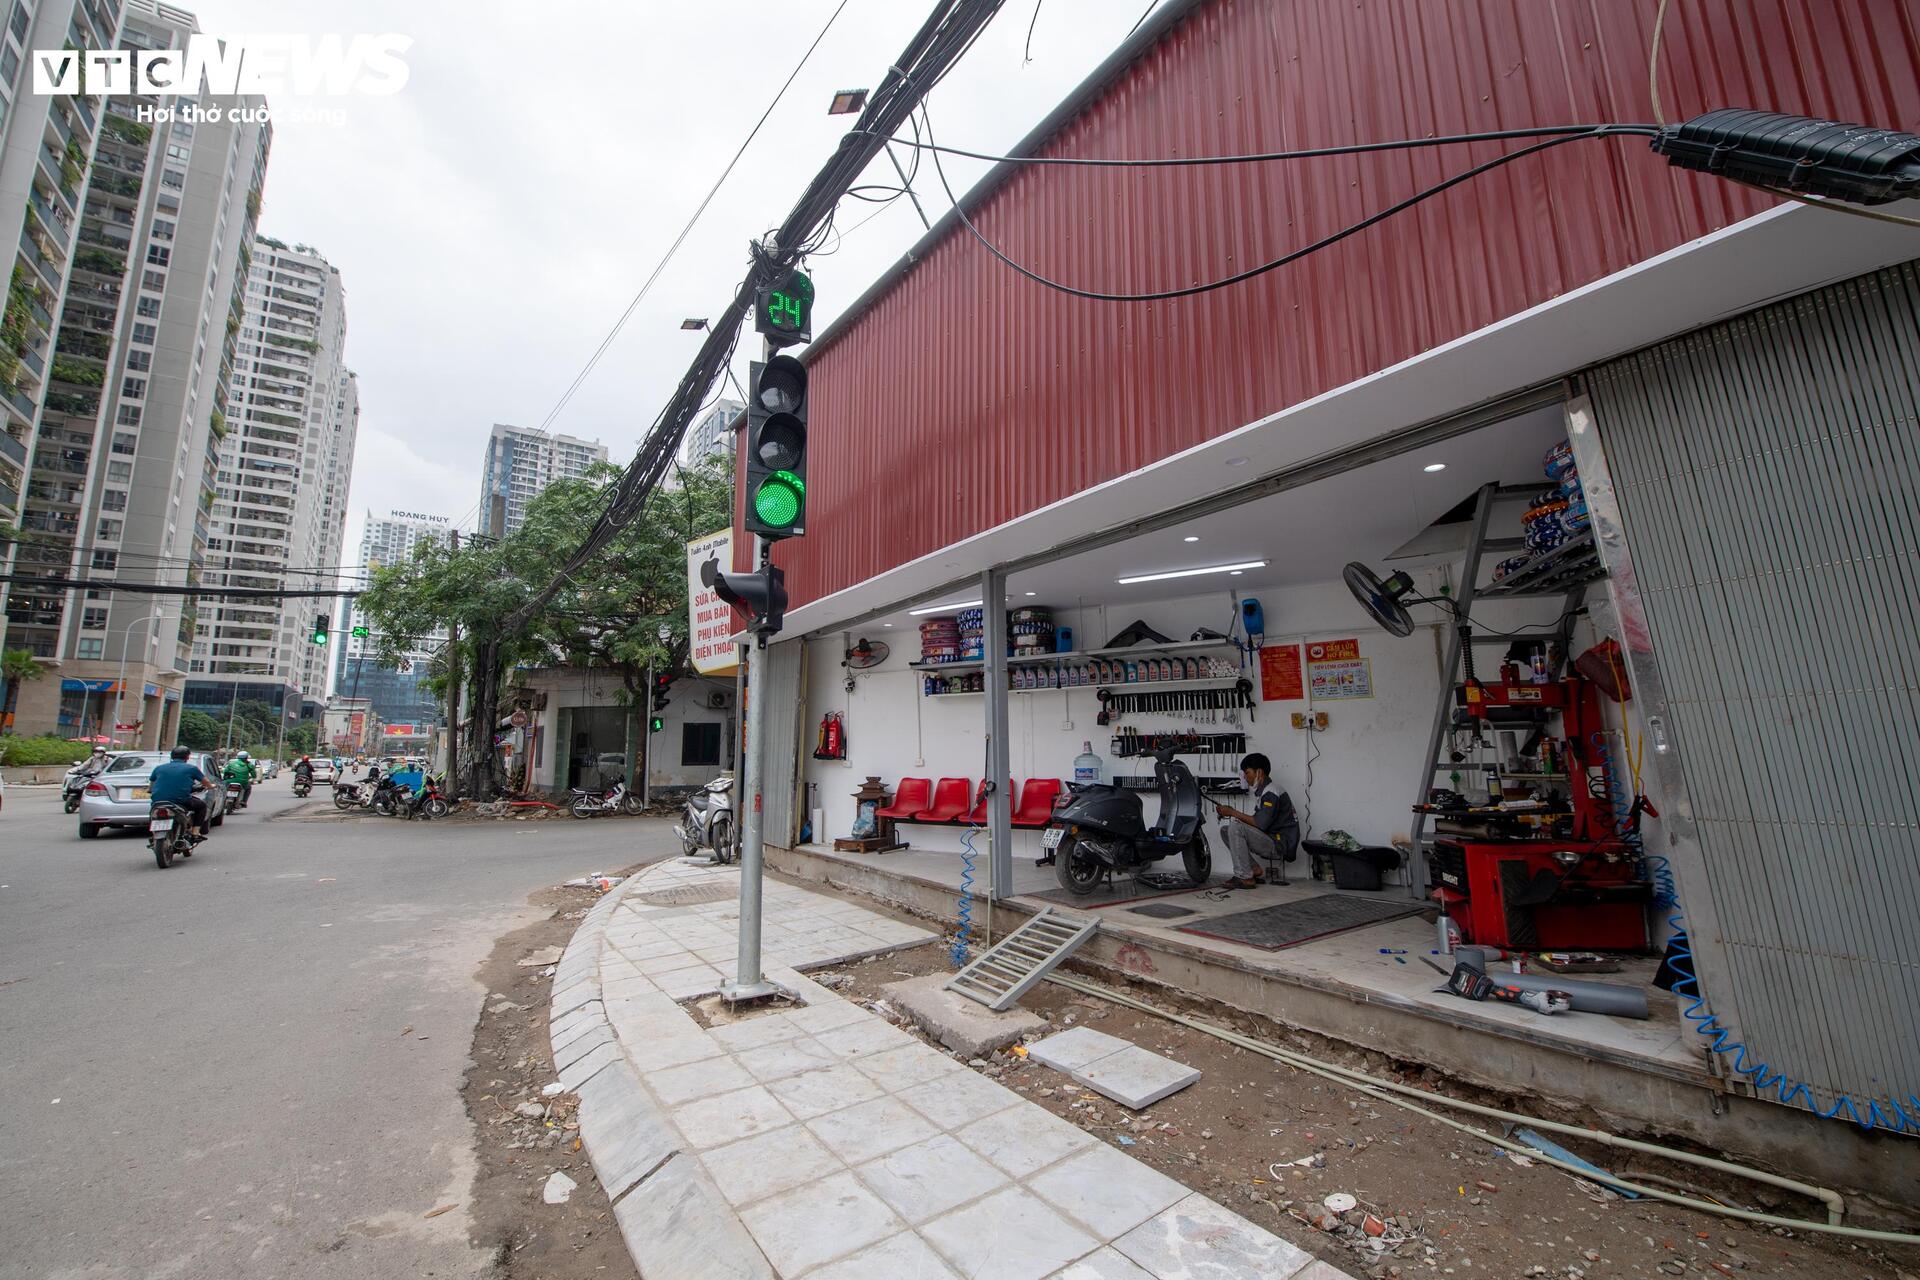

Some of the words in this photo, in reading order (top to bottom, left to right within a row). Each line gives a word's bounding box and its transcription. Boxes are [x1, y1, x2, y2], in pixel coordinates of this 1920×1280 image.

[768, 290, 800, 328] 24
[429, 515, 449, 523] HUY
[712, 537, 729, 549] Mobile
[697, 610, 713, 624] MUA
[714, 604, 729, 619] BÁN
[353, 627, 368, 637] 24
[697, 627, 712, 642] PHỤ
[713, 621, 730, 638] KIỆN
[695, 643, 712, 660] ĐIỆN
[713, 640, 735, 655] THOẠI
